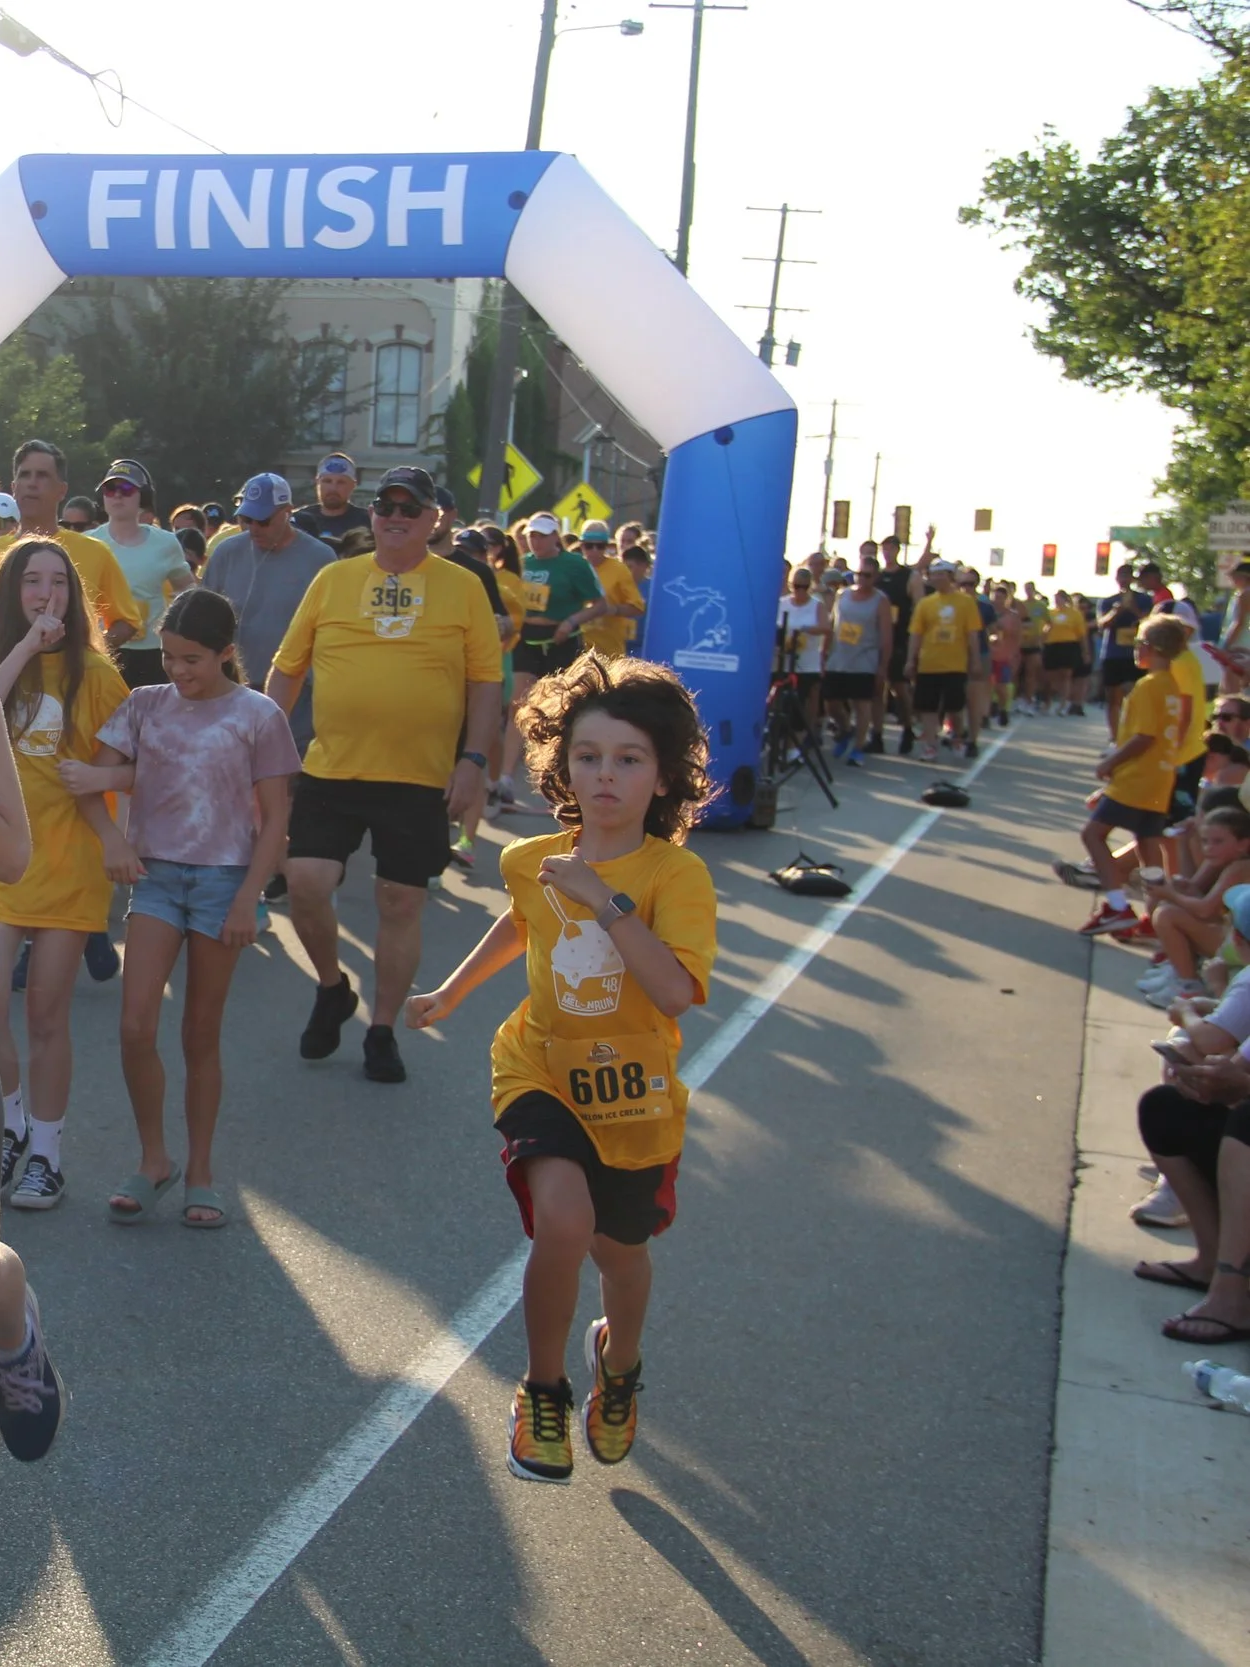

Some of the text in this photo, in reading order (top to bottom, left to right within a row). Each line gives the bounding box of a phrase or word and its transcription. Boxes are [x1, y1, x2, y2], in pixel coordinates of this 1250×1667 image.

[88, 164, 469, 250] FINISH
[370, 586, 412, 608] 356
[602, 976, 619, 993] 48
[569, 1062, 647, 1106] 608
[605, 1111, 617, 1119] ICE
[619, 1108, 646, 1117] CREAM
